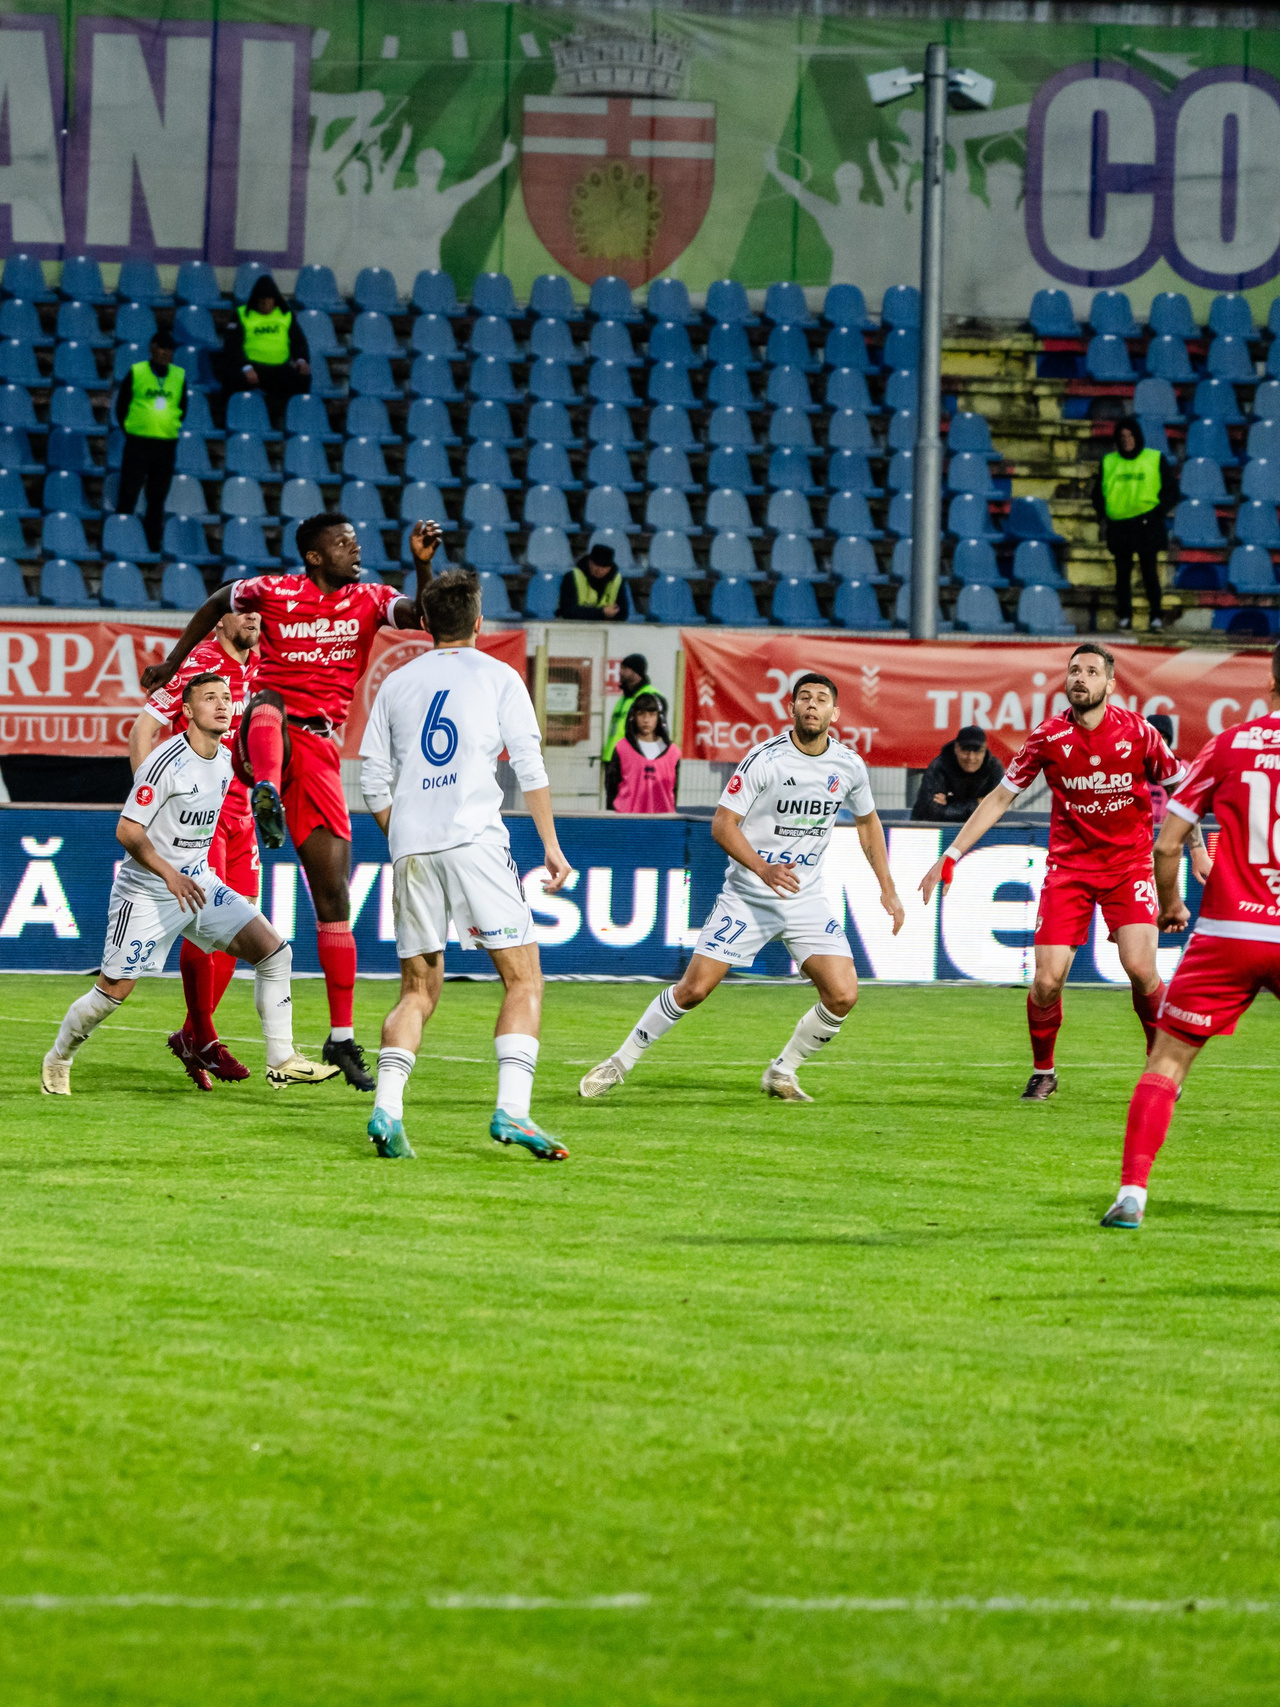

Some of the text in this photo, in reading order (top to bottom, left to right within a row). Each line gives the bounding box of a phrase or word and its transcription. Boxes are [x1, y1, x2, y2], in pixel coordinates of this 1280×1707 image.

[278, 618, 360, 639] WIN2.RO
[420, 689, 459, 767] 6
[422, 772, 458, 790] DICAN
[1061, 771, 1133, 791] WIN2.RO
[776, 799, 843, 816] UNIBET
[1238, 900, 1266, 913] 7777
[504, 927, 518, 935] Eco
[714, 915, 748, 945] 27
[126, 939, 157, 965] 33
